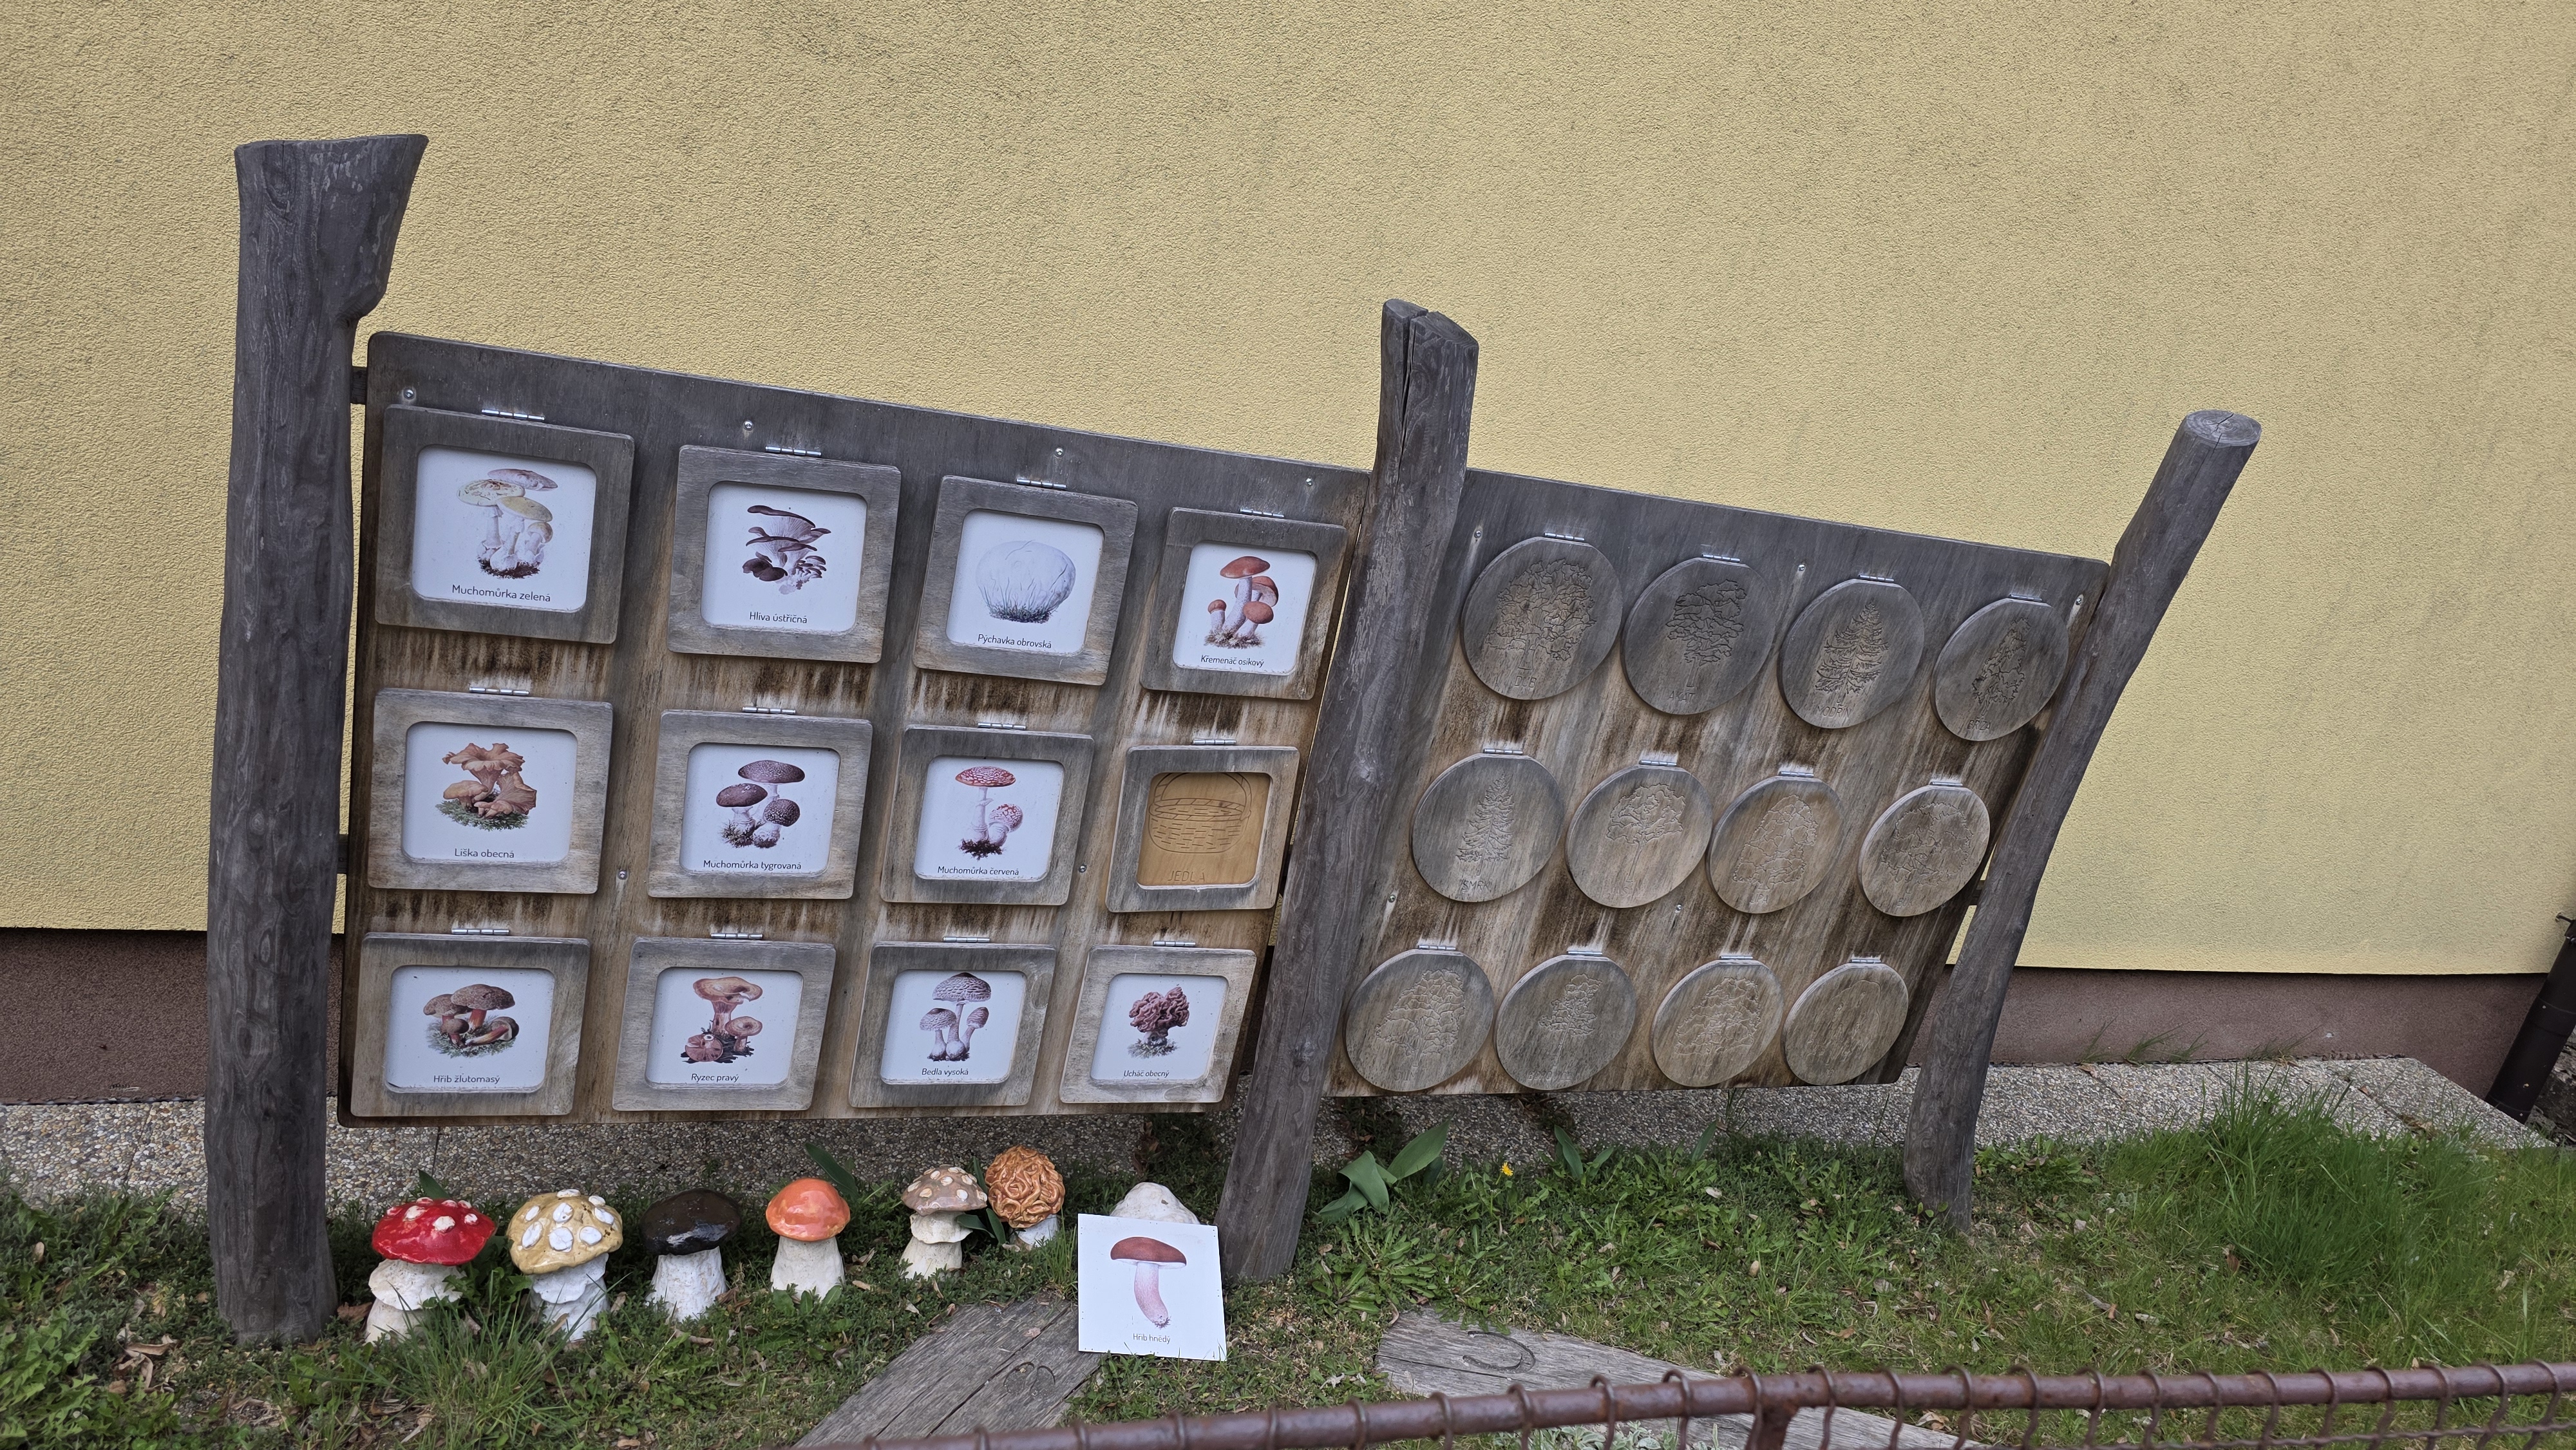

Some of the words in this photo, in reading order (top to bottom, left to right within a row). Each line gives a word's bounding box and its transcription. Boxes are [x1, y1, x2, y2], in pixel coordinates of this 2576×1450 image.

[452, 584, 517, 599] Muchomůrka
[519, 591, 551, 602] zelená
[750, 611, 770, 621] Hlíva
[773, 613, 808, 624] ústřičná
[978, 634, 1015, 645] Pýchavka
[1016, 637, 1052, 648] obrovská
[1200, 654, 1237, 664] Křemenáč
[1238, 657, 1265, 668] osikový
[1515, 675, 1537, 688] DUB
[455, 848, 478, 857] Liška
[480, 849, 515, 858] obecná
[703, 860, 759, 869] Muchomůrka
[761, 862, 802, 871] tygrovaná
[938, 865, 988, 874] Muchomůrka
[989, 867, 1019, 876] červená
[691, 1073, 715, 1082] Ryzec
[716, 1074, 739, 1083] pravý
[943, 1068, 969, 1077] vysoká
[1145, 1069, 1170, 1078] obecný
[433, 1075, 452, 1083] Hřib
[454, 1075, 500, 1084] žlutomasý
[1133, 1333, 1148, 1341] Hřib
[1149, 1333, 1171, 1344] hnědý
